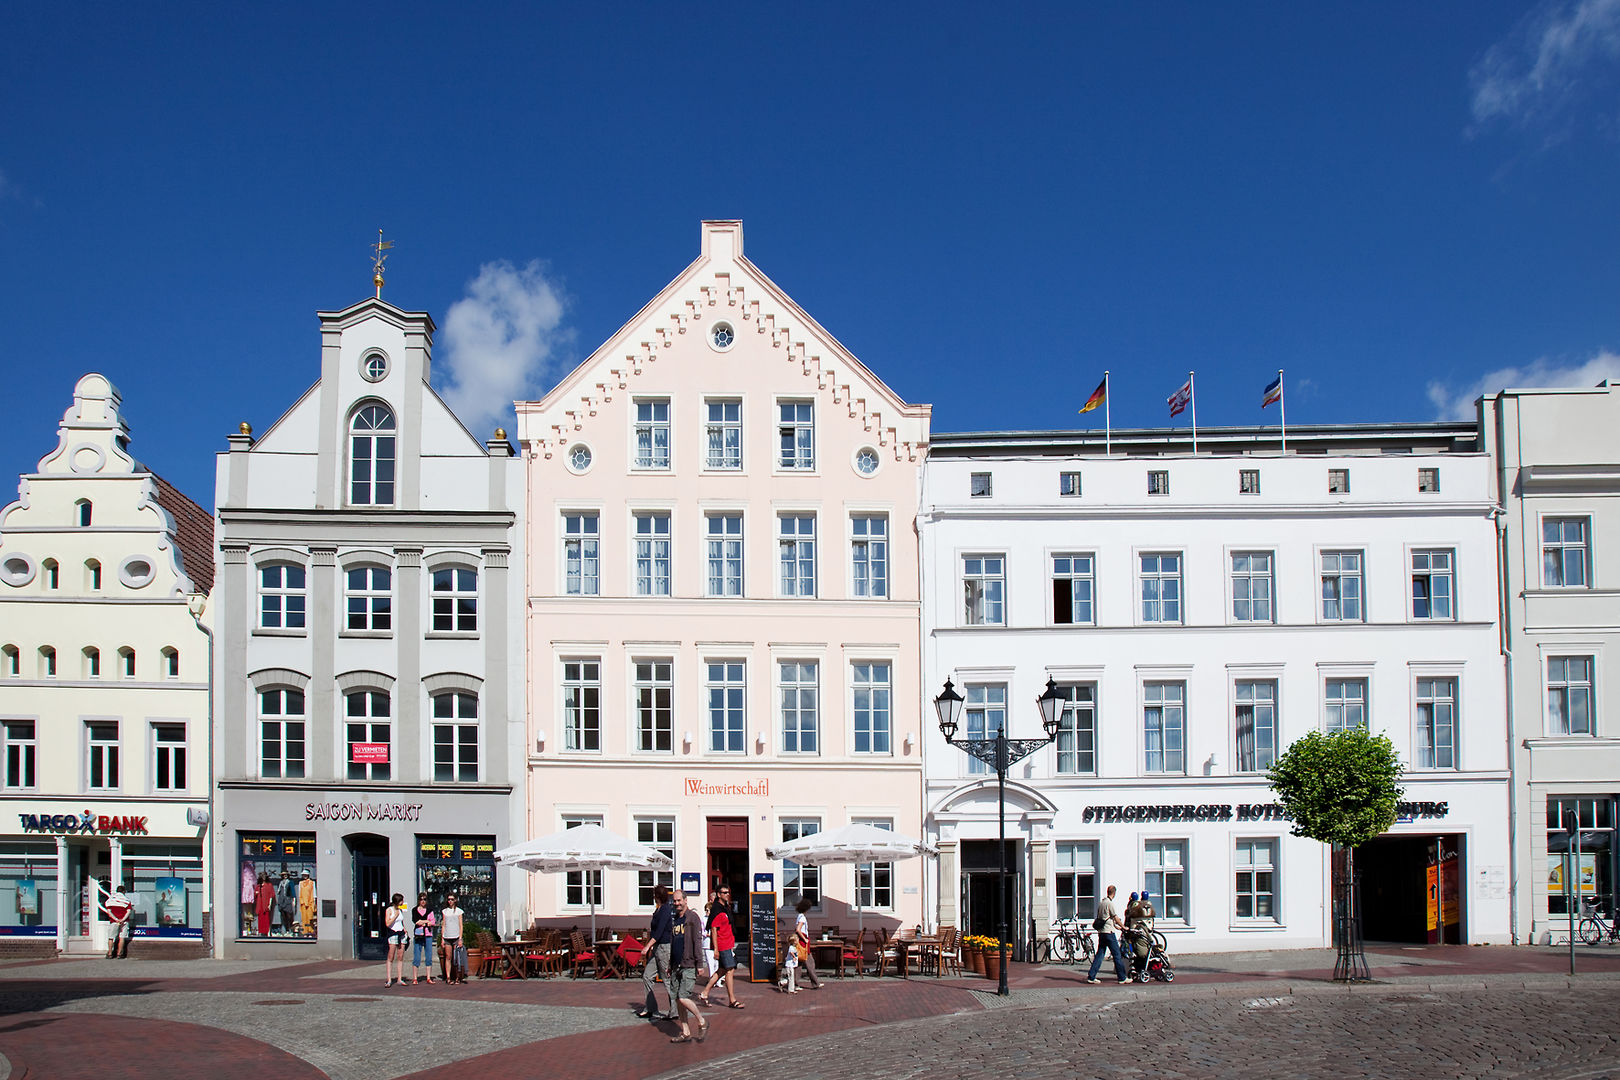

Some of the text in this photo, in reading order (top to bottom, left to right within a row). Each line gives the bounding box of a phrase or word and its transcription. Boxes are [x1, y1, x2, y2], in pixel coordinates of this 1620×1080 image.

[687, 779, 767, 795] Weinwirtschaft
[305, 802, 423, 821] SAIGON MARKT
[1083, 804, 1233, 821] STEIGENBERGER
[1396, 801, 1450, 817] BURG
[18, 813, 147, 831] TARGO BANK
